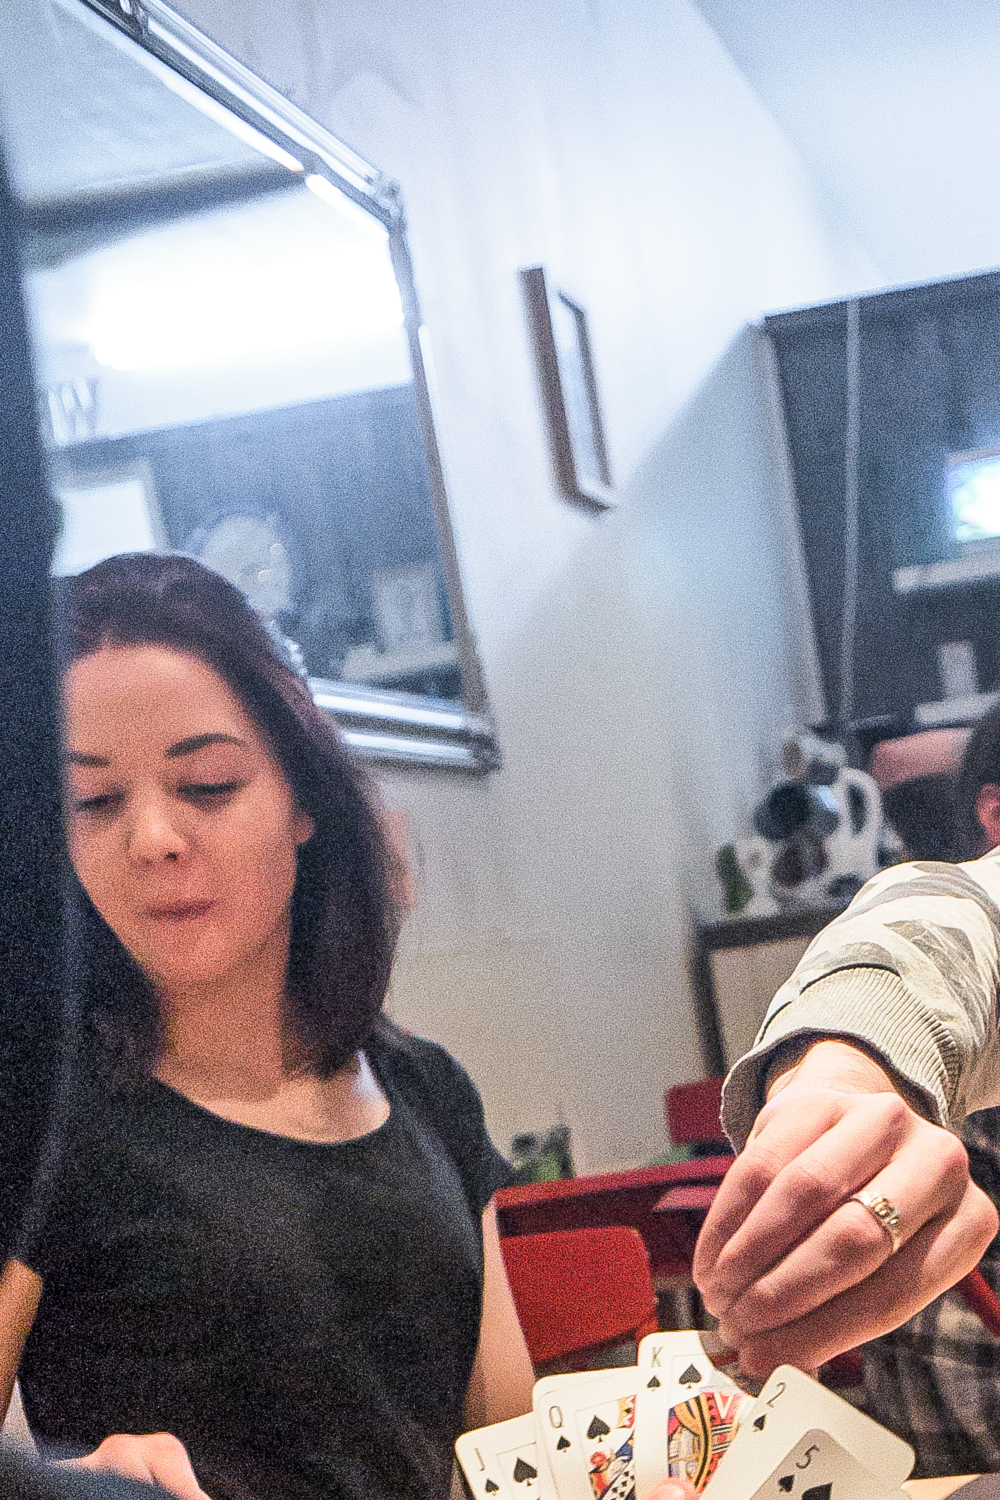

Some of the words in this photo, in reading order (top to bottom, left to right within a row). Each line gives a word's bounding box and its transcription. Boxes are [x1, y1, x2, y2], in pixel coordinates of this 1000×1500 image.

[651, 1346, 664, 1368] K
[766, 1382, 786, 1408] 2
[548, 1405, 564, 1429] Q
[474, 1447, 486, 1472] J
[796, 1444, 820, 1470] 5
